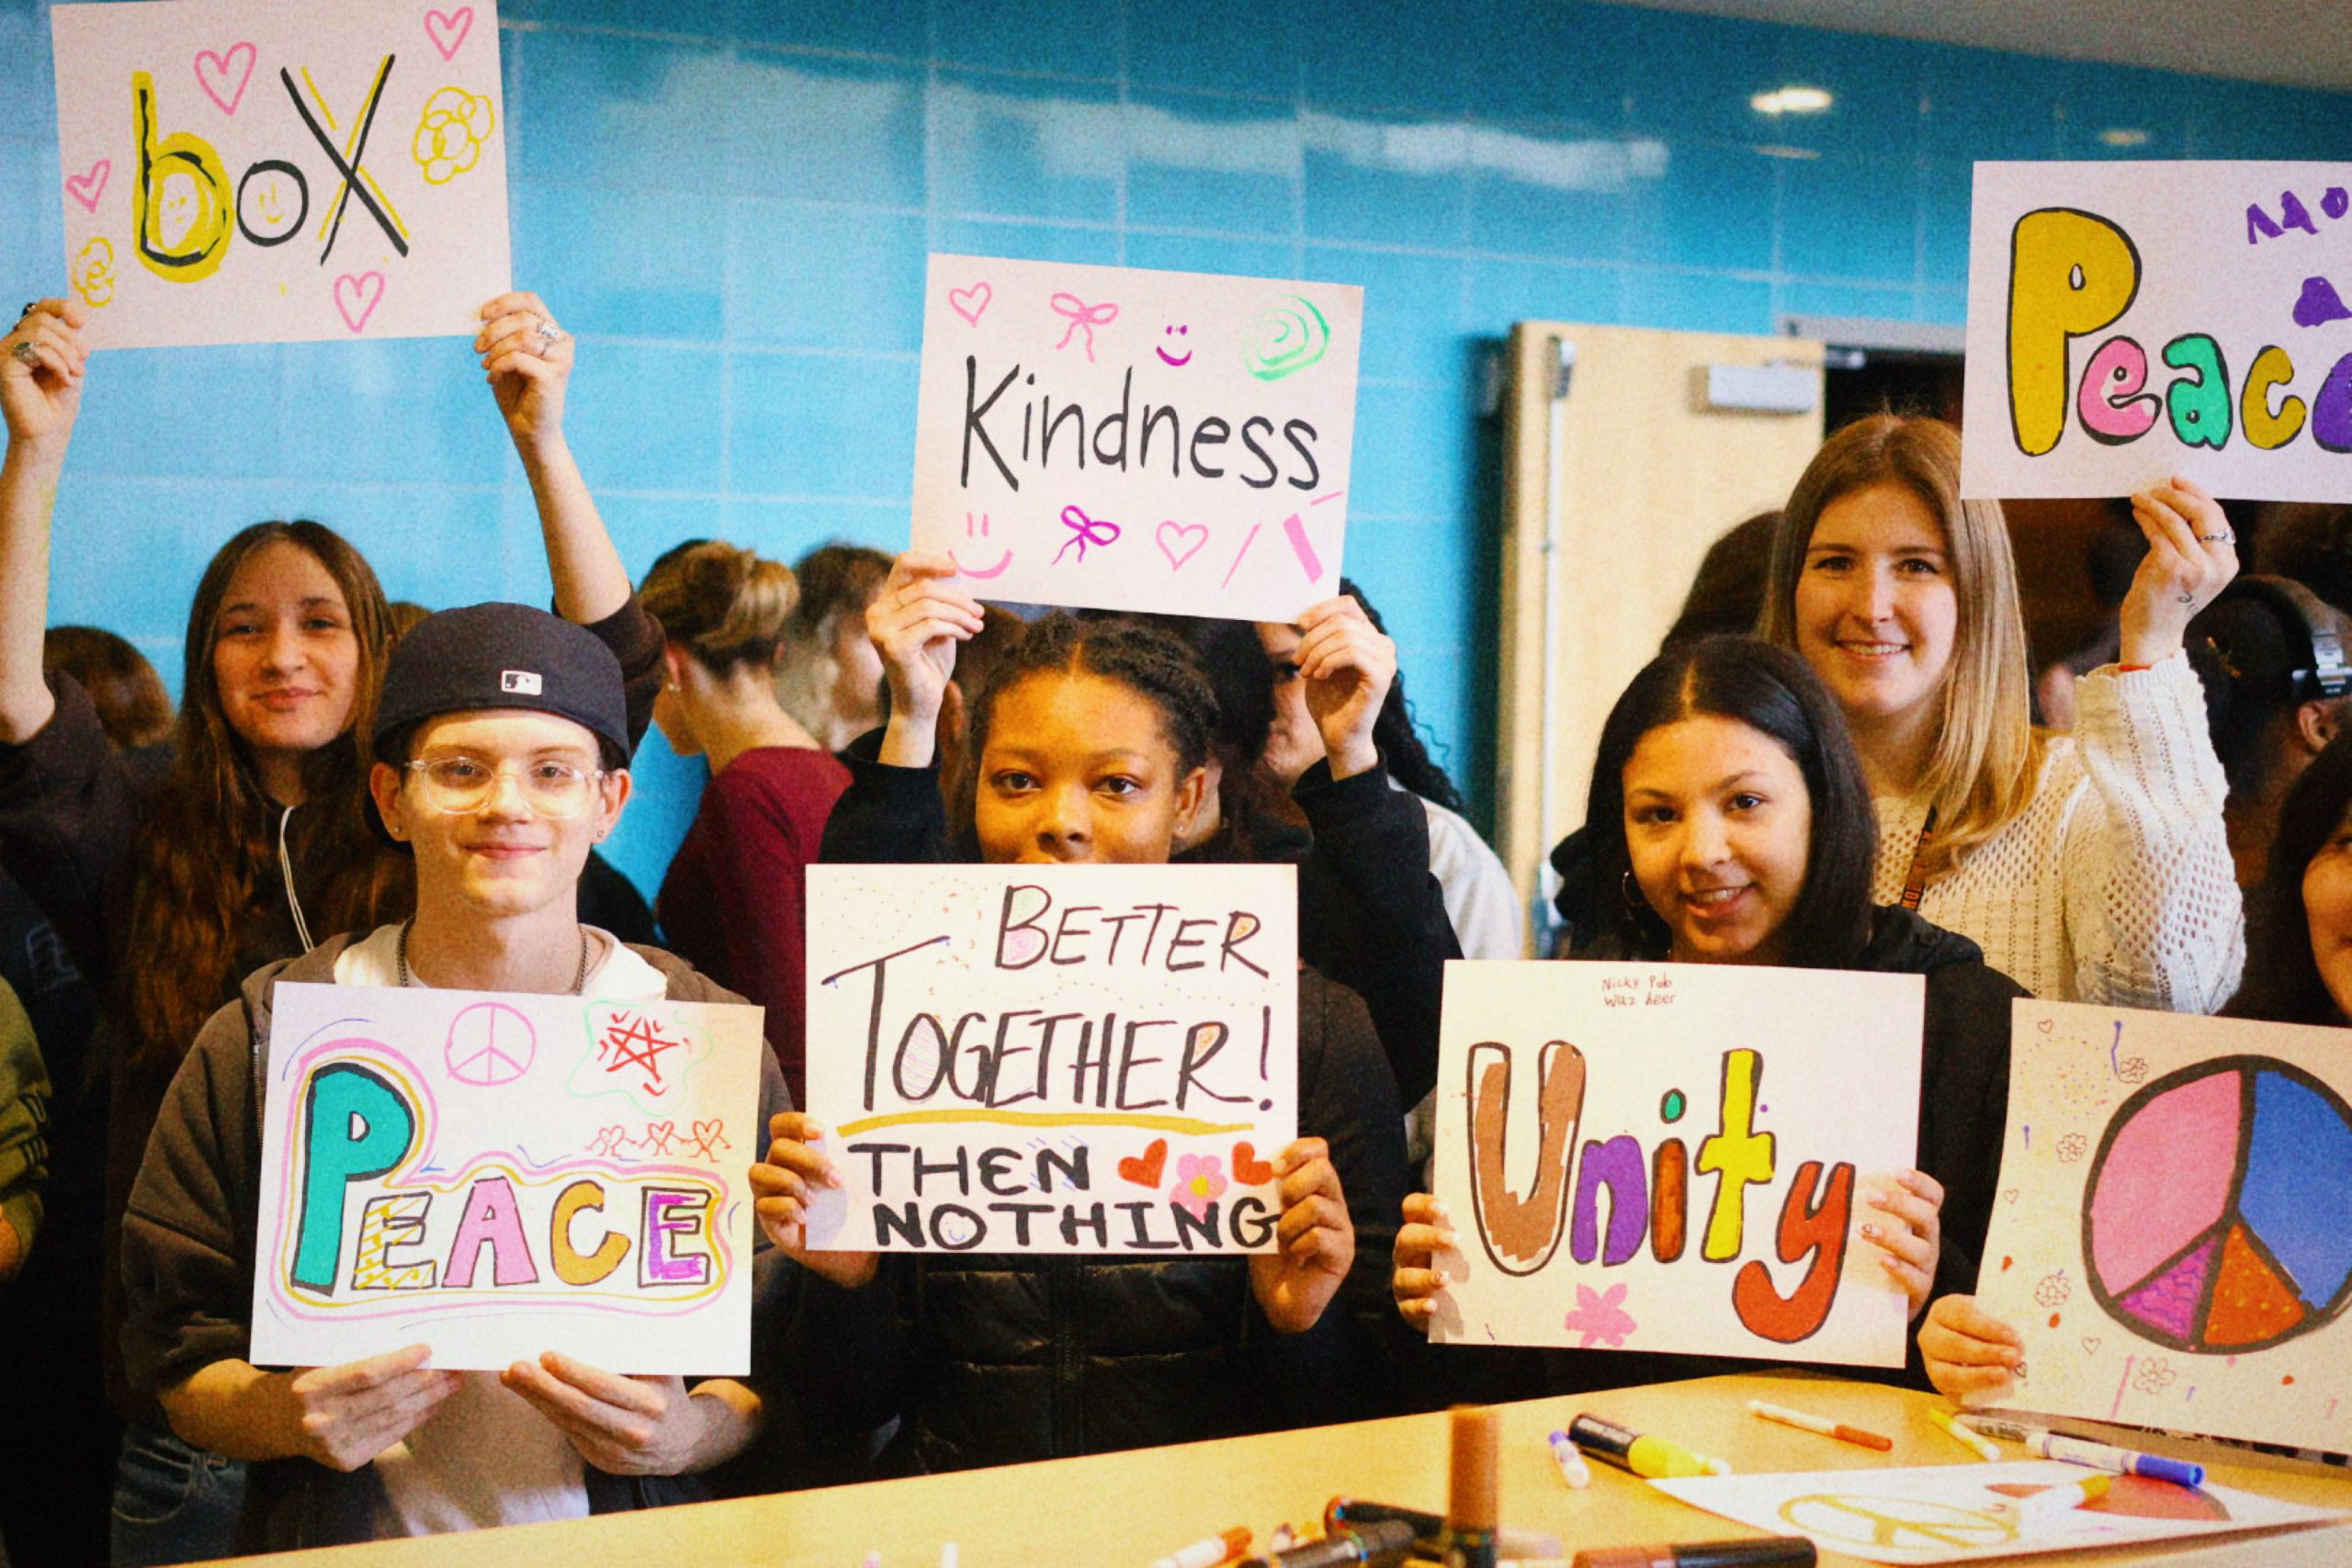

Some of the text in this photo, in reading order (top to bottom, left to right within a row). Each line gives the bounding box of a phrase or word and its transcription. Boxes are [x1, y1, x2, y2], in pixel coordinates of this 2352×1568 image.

[960, 355, 1320, 491] Kindness
[996, 885, 1269, 979] BETTER
[821, 935, 1276, 1112] TOGETHER!
[290, 1062, 712, 1297] PEACE
[847, 1143, 1091, 1197] THEN
[873, 1201, 1282, 1250] NOTHING
[1466, 1040, 1856, 1344] Unity
